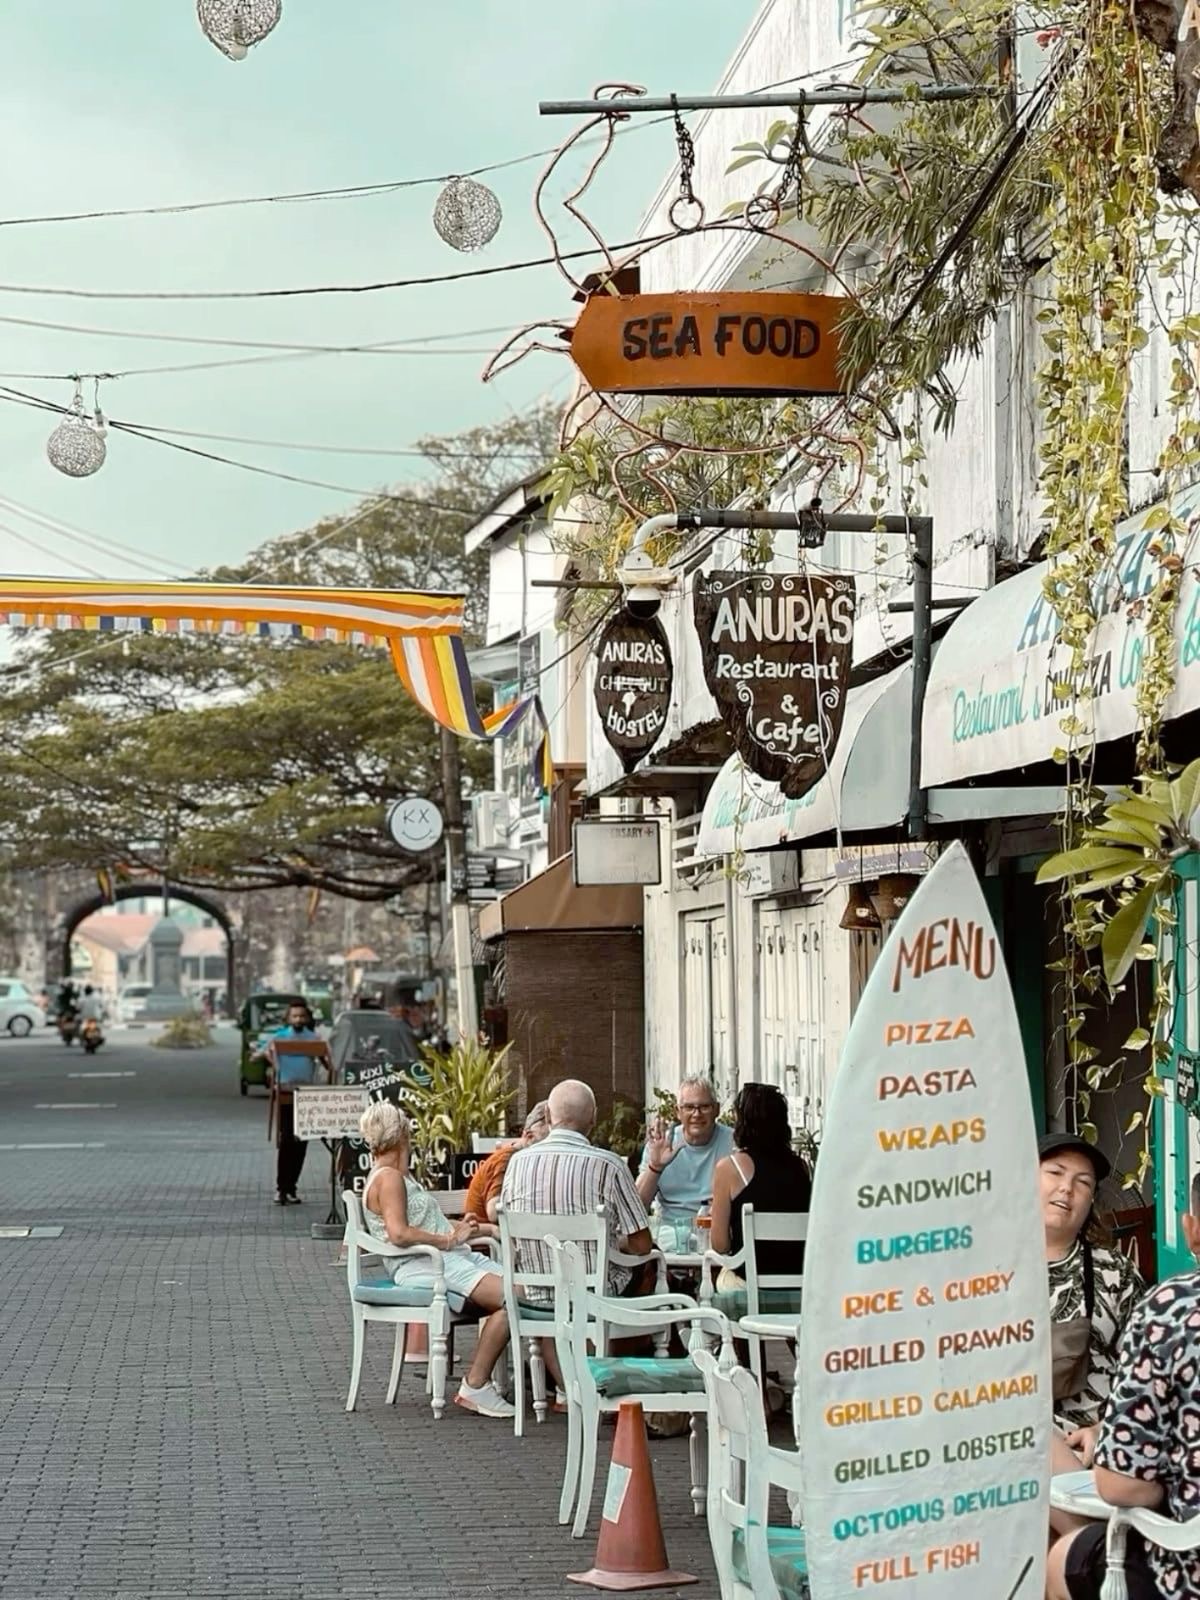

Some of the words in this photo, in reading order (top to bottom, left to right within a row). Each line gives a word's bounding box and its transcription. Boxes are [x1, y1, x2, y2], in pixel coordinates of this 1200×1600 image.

[622, 314, 702, 361] SEA
[714, 314, 821, 359] FOOD
[710, 586, 854, 645] ANURA'S
[602, 639, 665, 665] ANURA'S
[716, 654, 840, 680] Restaurant
[606, 705, 665, 739] HOSTEL
[780, 694, 799, 715] &
[756, 717, 821, 751] Cafe
[893, 917, 996, 992] MENU
[886, 1017, 976, 1047] PIZZA
[878, 1069, 978, 1101] PASTA
[878, 1117, 987, 1152] WRAPS
[857, 1169, 992, 1209] SANDWICH
[857, 1225, 973, 1264] BURGERS
[844, 1290, 904, 1319] RICE
[916, 1286, 935, 1307] &
[944, 1271, 1015, 1303] CURRY
[825, 1339, 925, 1374] GRILLED
[938, 1318, 1035, 1359] PRAWNS
[826, 1395, 923, 1427] GRILLED
[934, 1374, 1038, 1413] CALAMARI
[834, 1448, 930, 1484] GRILLED
[943, 1426, 1036, 1463] LOBSTER
[833, 1498, 945, 1541] OCTOPUS
[953, 1479, 1040, 1516] DEVILLED
[855, 1556, 919, 1588] FULL
[927, 1541, 981, 1574] FISH
